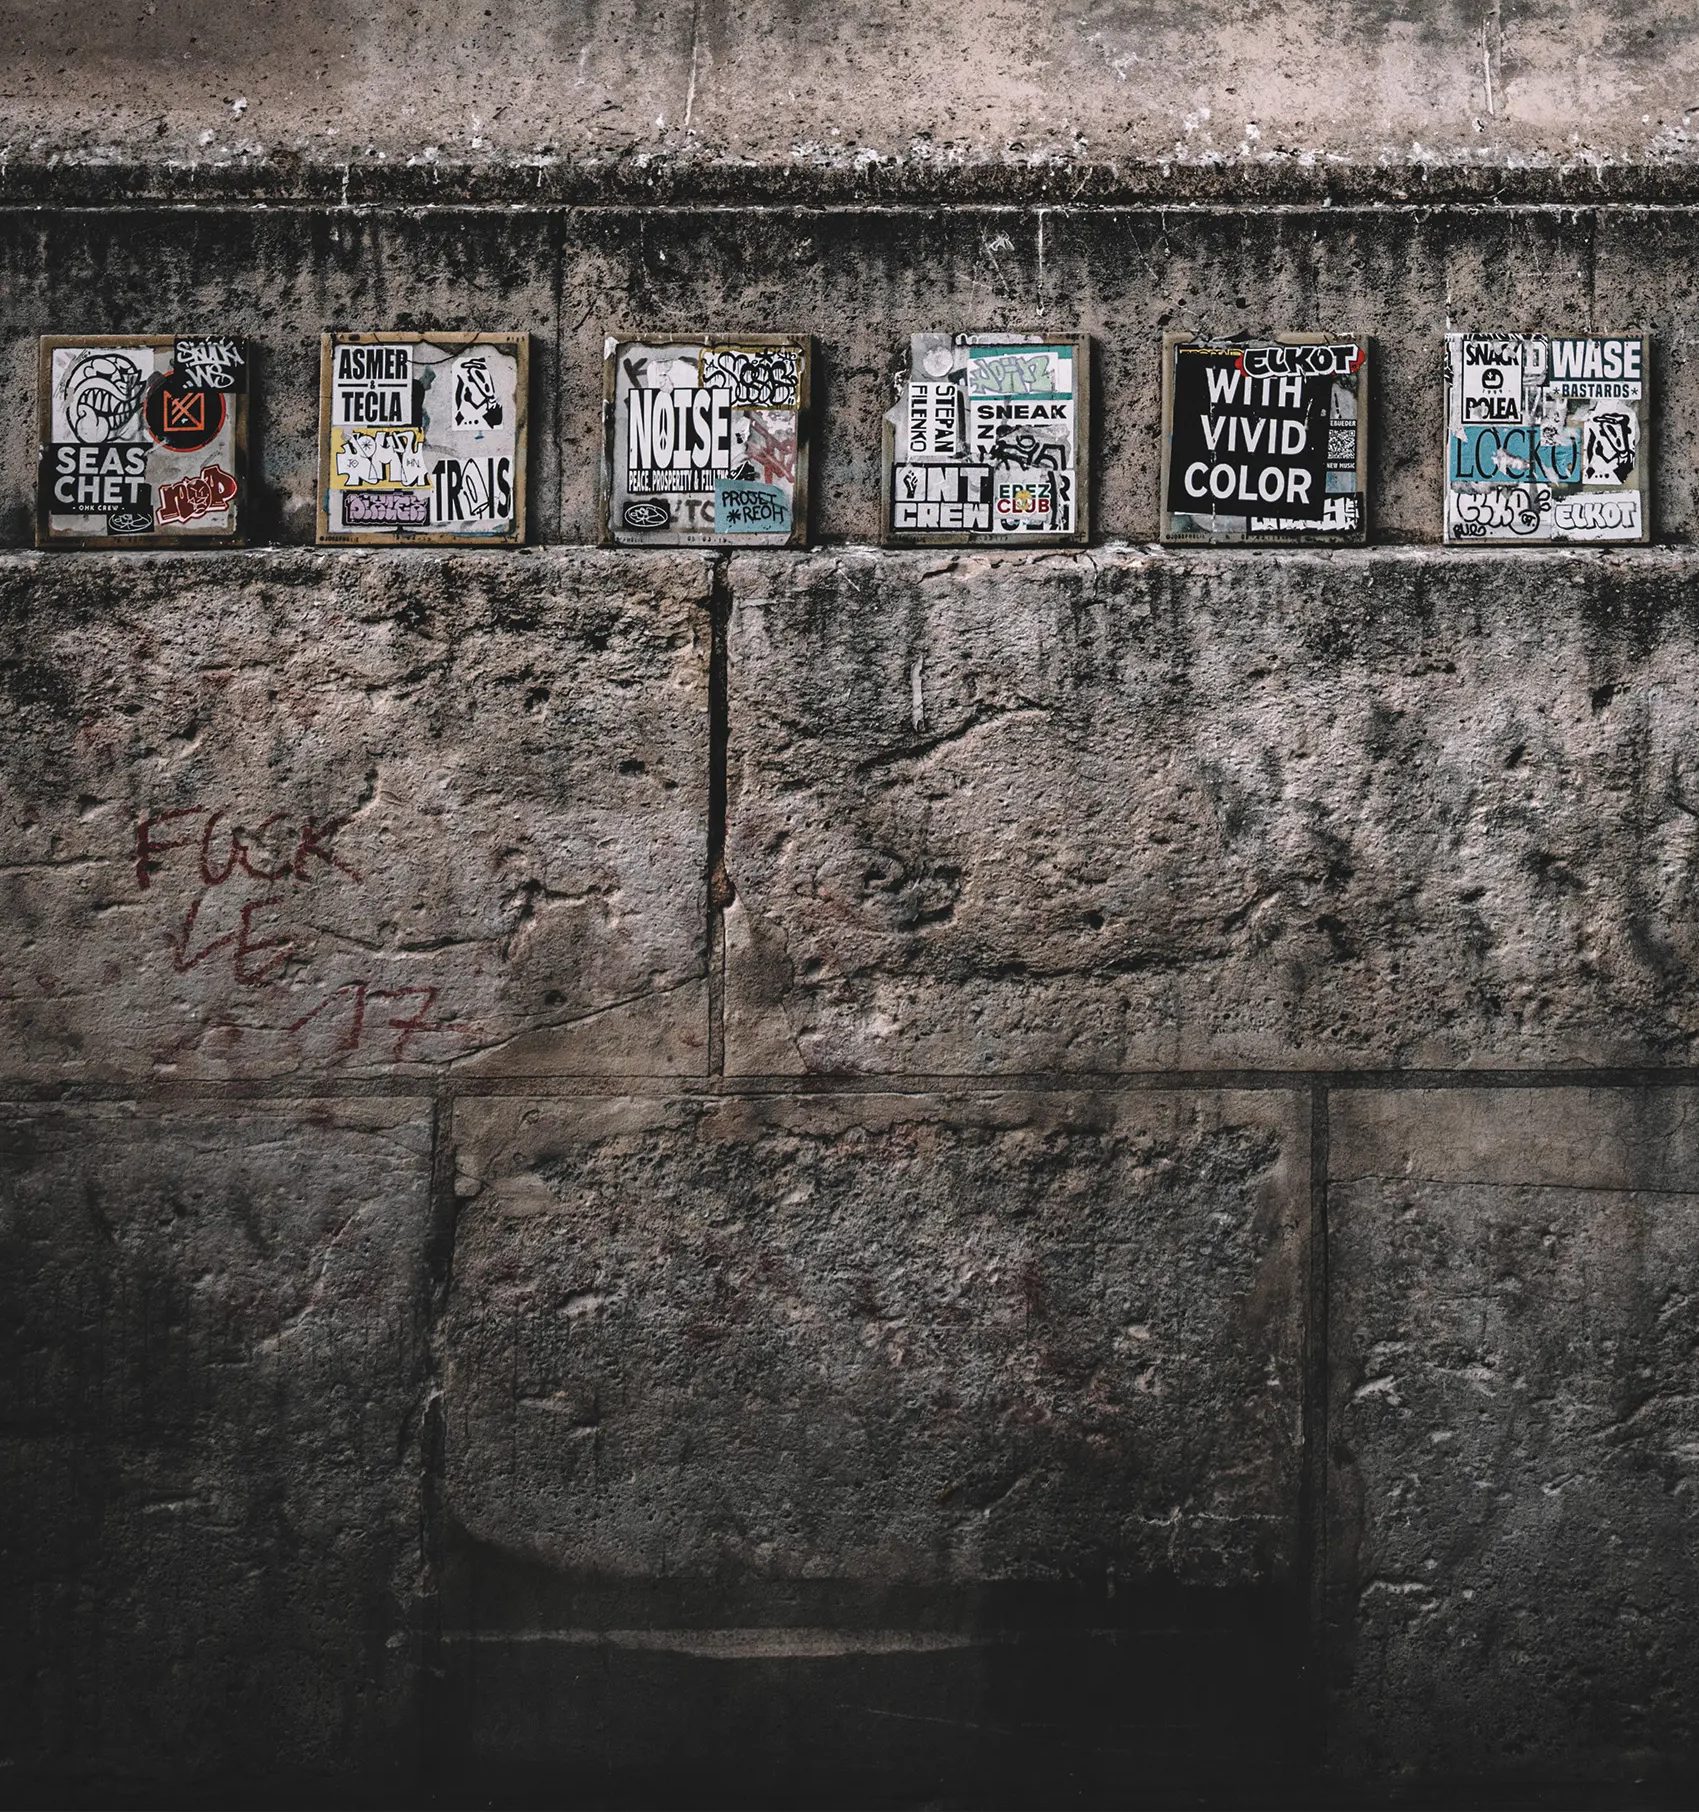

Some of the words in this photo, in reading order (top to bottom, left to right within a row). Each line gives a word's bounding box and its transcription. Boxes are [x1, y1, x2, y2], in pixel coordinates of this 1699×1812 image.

[339, 349, 408, 379] ASMER
[1552, 341, 1641, 378] WASE
[1206, 368, 1302, 408] WITH
[342, 391, 403, 422] TECLA
[911, 385, 927, 452] FILENKO
[934, 385, 956, 453] STEPAN
[977, 405, 1067, 420] SNEAK
[1465, 397, 1519, 419] POLEA
[629, 389, 731, 469] NOISE
[1200, 414, 1306, 455] VIVID
[56, 447, 145, 475] SEAS
[54, 476, 144, 504] CHET
[652, 470, 692, 491] PROSPERITY
[1184, 462, 1312, 504] COLOR
[894, 503, 989, 528] CREW
[997, 499, 1050, 513] CLUB
[135, 802, 363, 889] FUCK
